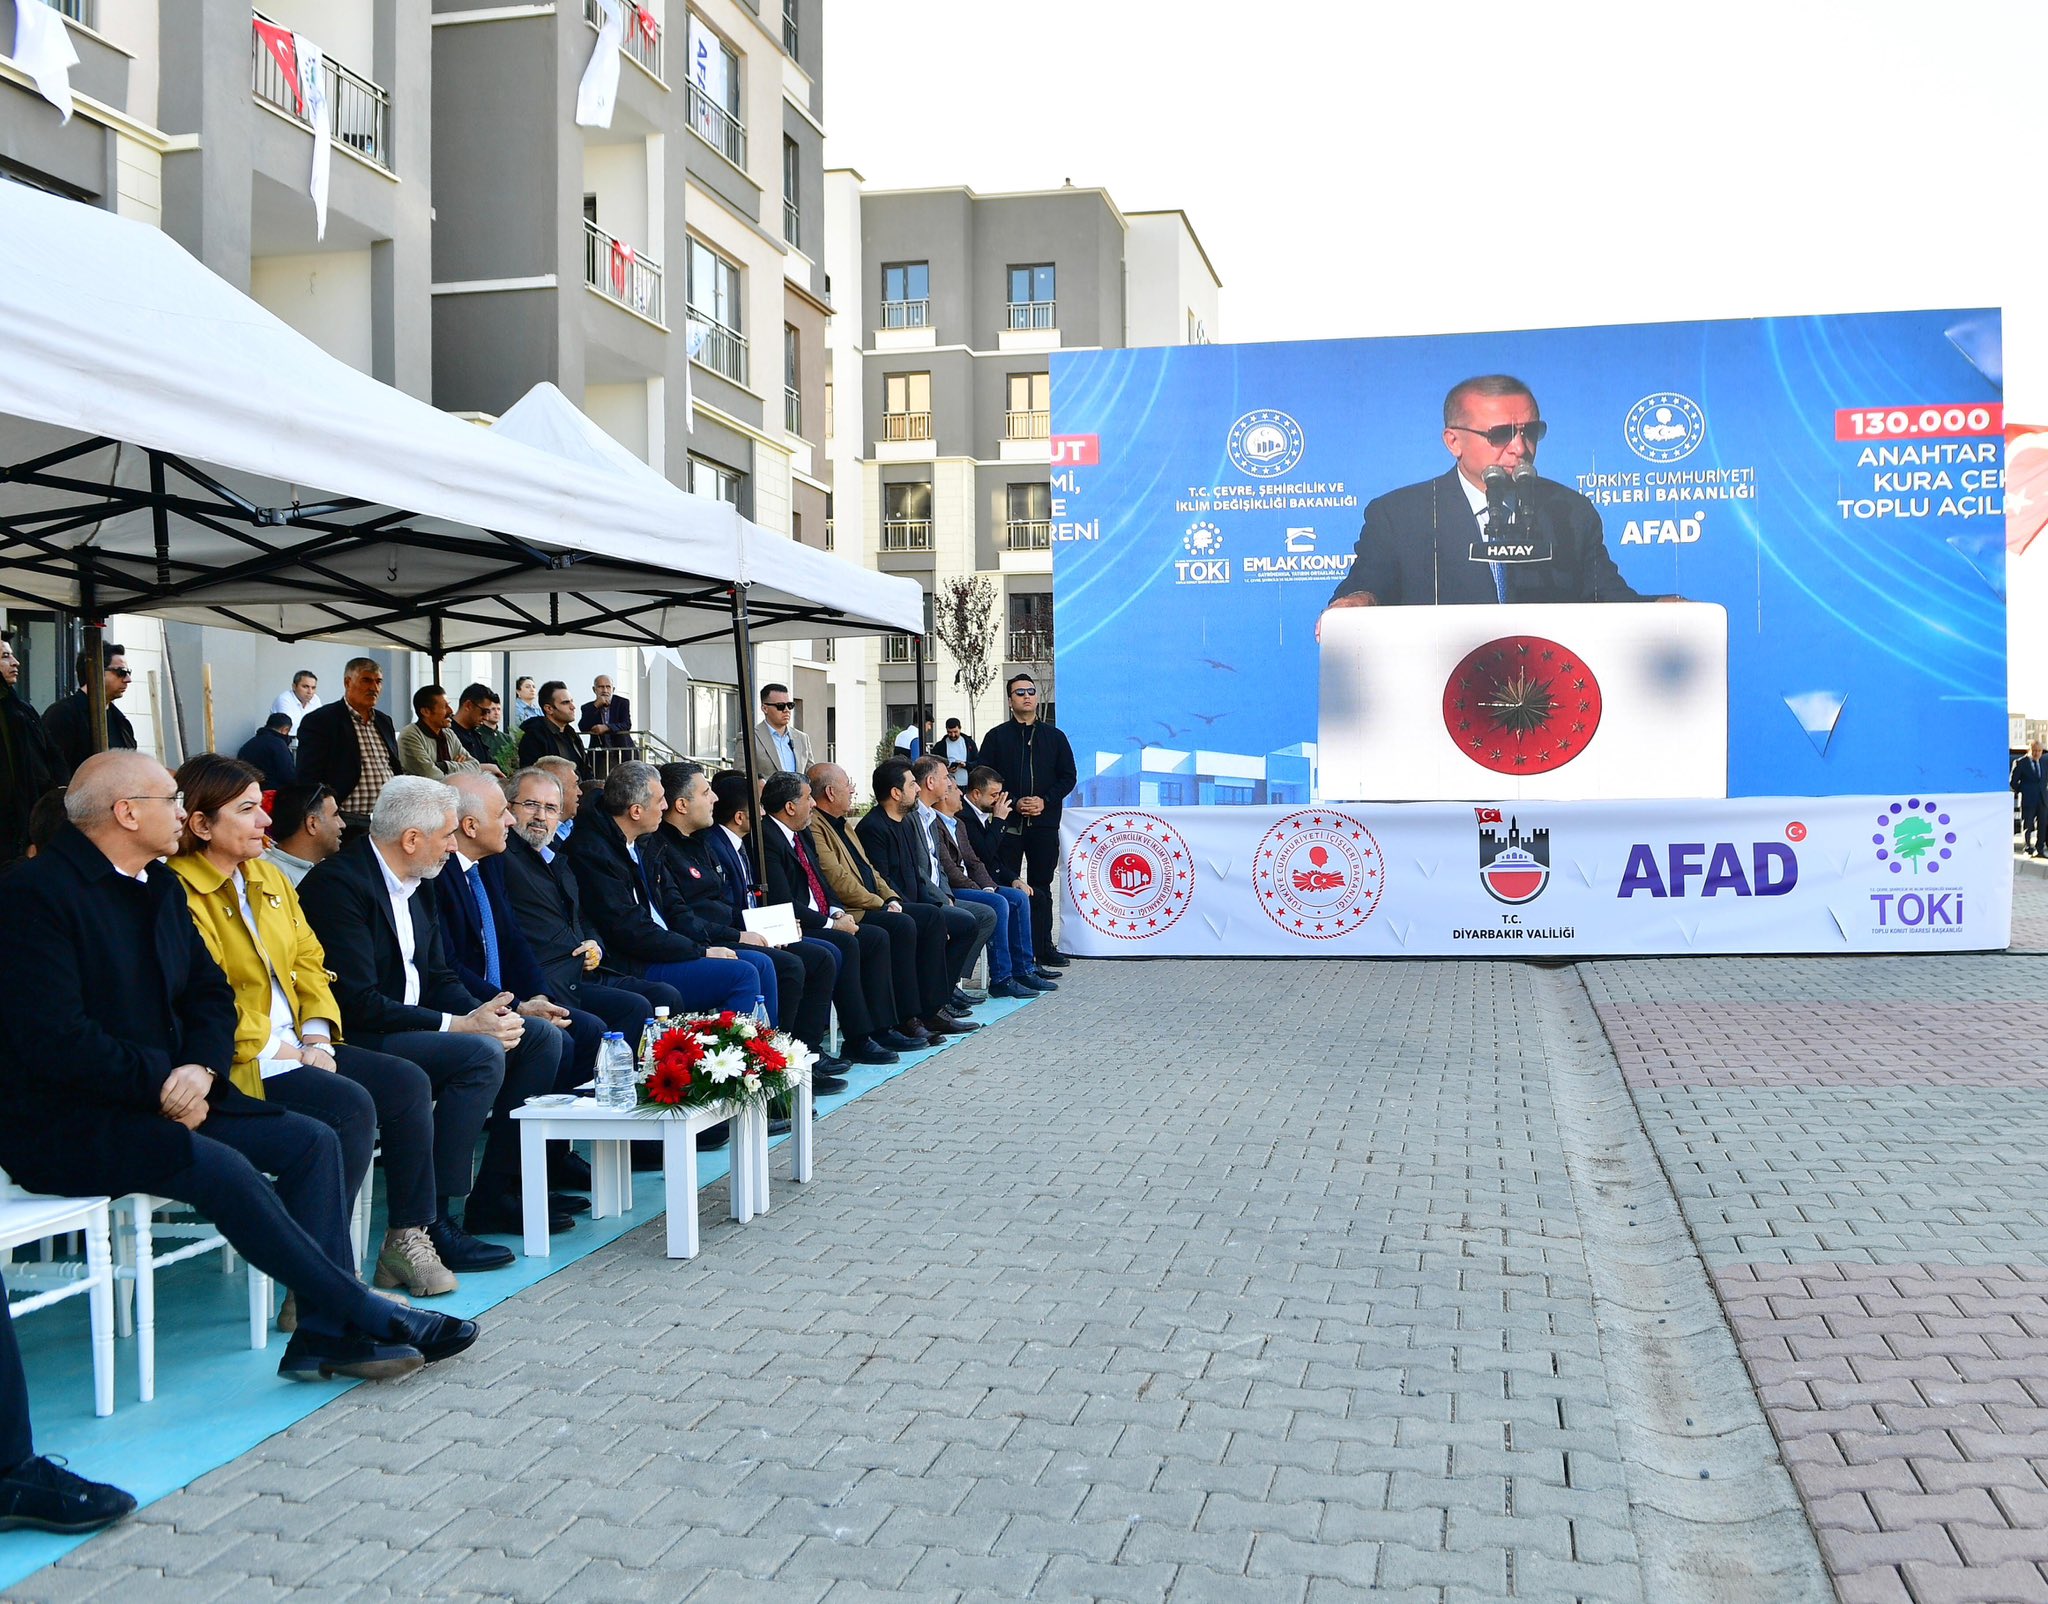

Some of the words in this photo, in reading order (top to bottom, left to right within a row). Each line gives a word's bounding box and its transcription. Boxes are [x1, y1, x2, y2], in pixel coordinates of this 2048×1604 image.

[1851, 408, 1991, 435] 130.000
[1857, 443, 1997, 467] ANAHTAR
[1576, 472, 1641, 488] TÜRKİYE
[1645, 466, 1755, 485] CUMHURİYETİ
[1874, 471, 1953, 493] KURA
[1188, 487, 1211, 497] T.C.
[1213, 485, 1256, 499] ÇEVRE,
[1259, 481, 1326, 497] ŞEHİRCİLİK
[1328, 482, 1344, 493] VE
[1656, 483, 1755, 502] BAKANLIĞI
[1176, 499, 1211, 512] İKLİM
[1213, 496, 1287, 513] DEĞİŞİKLİĞİ
[1290, 495, 1358, 509] BAKANLIĞI
[1837, 497, 1929, 520] TOPLU
[1620, 519, 1701, 545] AFAD
[1487, 545, 1534, 556] HATAY
[1243, 556, 1299, 572] EMLAK
[1301, 554, 1358, 571] KONUT
[1110, 833, 1142, 846] ŞEHİRCİLİK
[1150, 841, 1165, 857] İKLİM
[1276, 831, 1323, 873] CUMHURİYETİ
[1326, 832, 1357, 862] İÇİŞLERİ
[1617, 842, 1799, 898] AFAD
[1277, 877, 1302, 911] TÜRKİYE
[1336, 863, 1360, 910] BAKANLIĞI
[1502, 914, 1522, 924] T.C.
[1453, 928, 1523, 939] DİYARBAKIR
[1526, 926, 1575, 939] VALİLİĞİ
